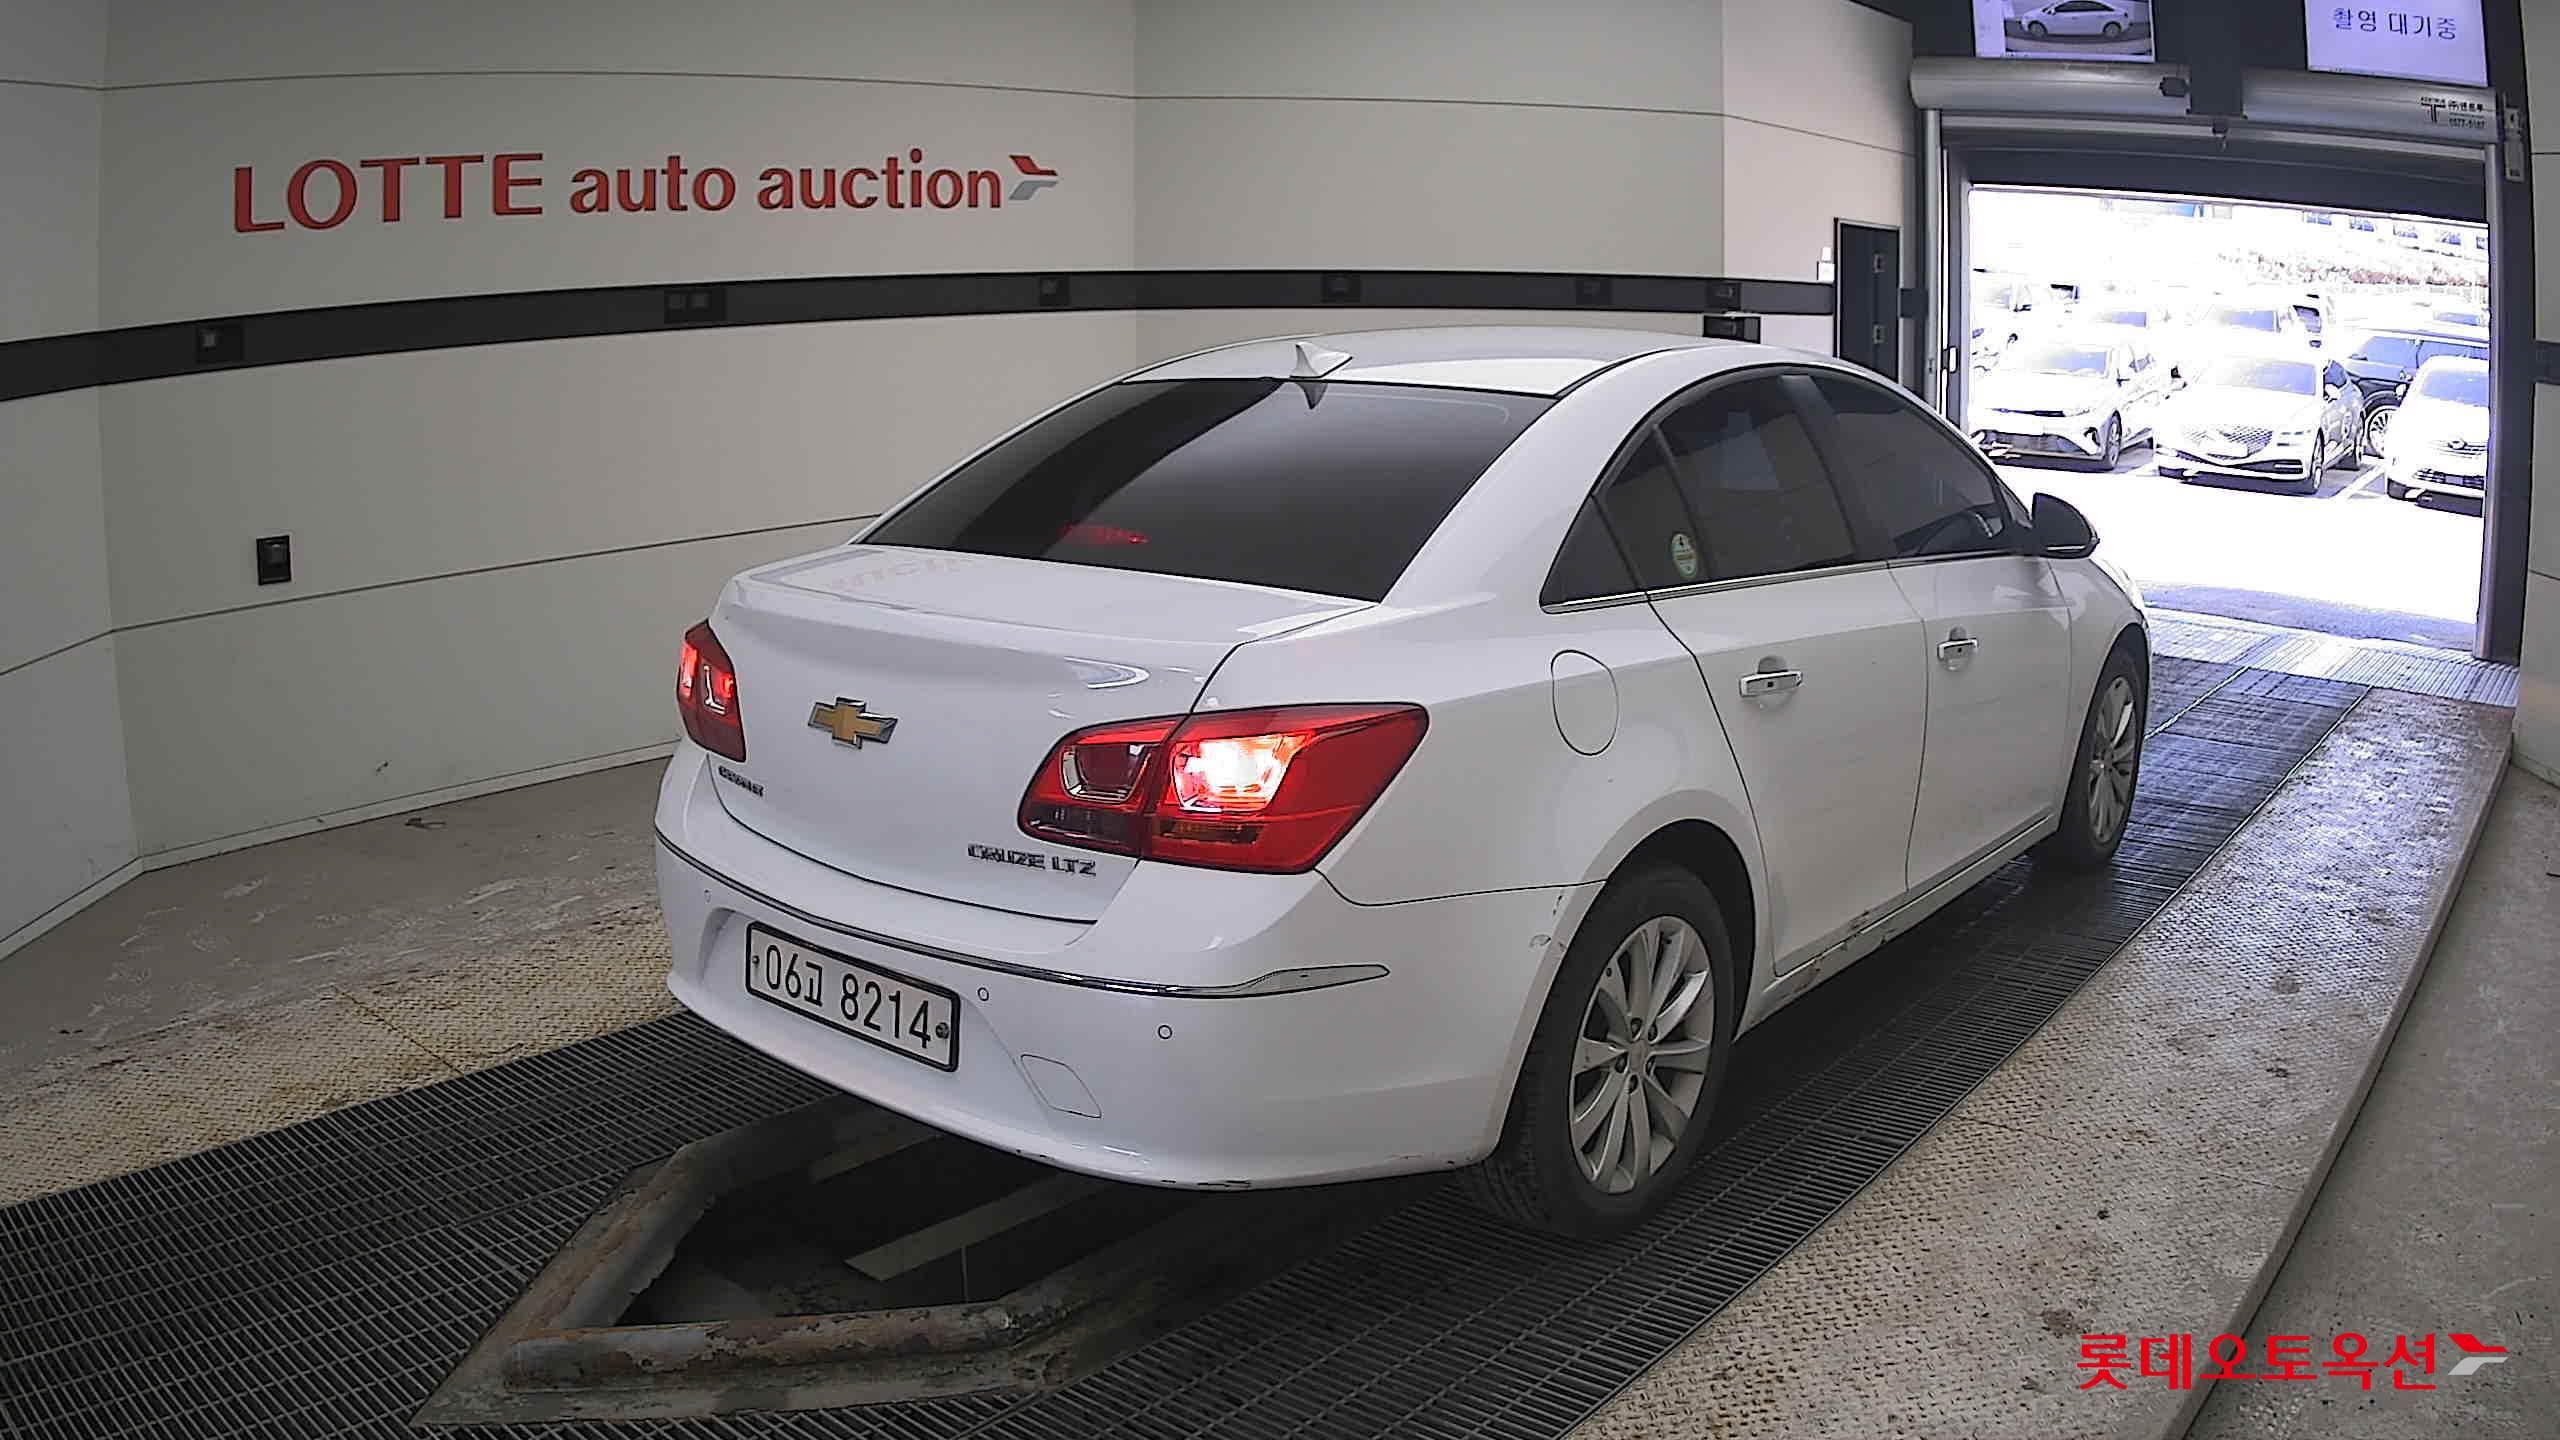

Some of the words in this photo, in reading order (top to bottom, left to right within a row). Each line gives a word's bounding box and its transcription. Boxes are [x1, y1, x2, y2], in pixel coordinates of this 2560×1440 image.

[2388, 12, 2457, 40] 대기중
[234, 153, 543, 233] LOTTE
[570, 155, 736, 213] auto
[757, 148, 1001, 209] auction
[967, 844, 1046, 870] CRUZE
[1051, 856, 1097, 877] LTZ
[766, 944, 823, 1007] 06고
[840, 973, 931, 1049] 8214
